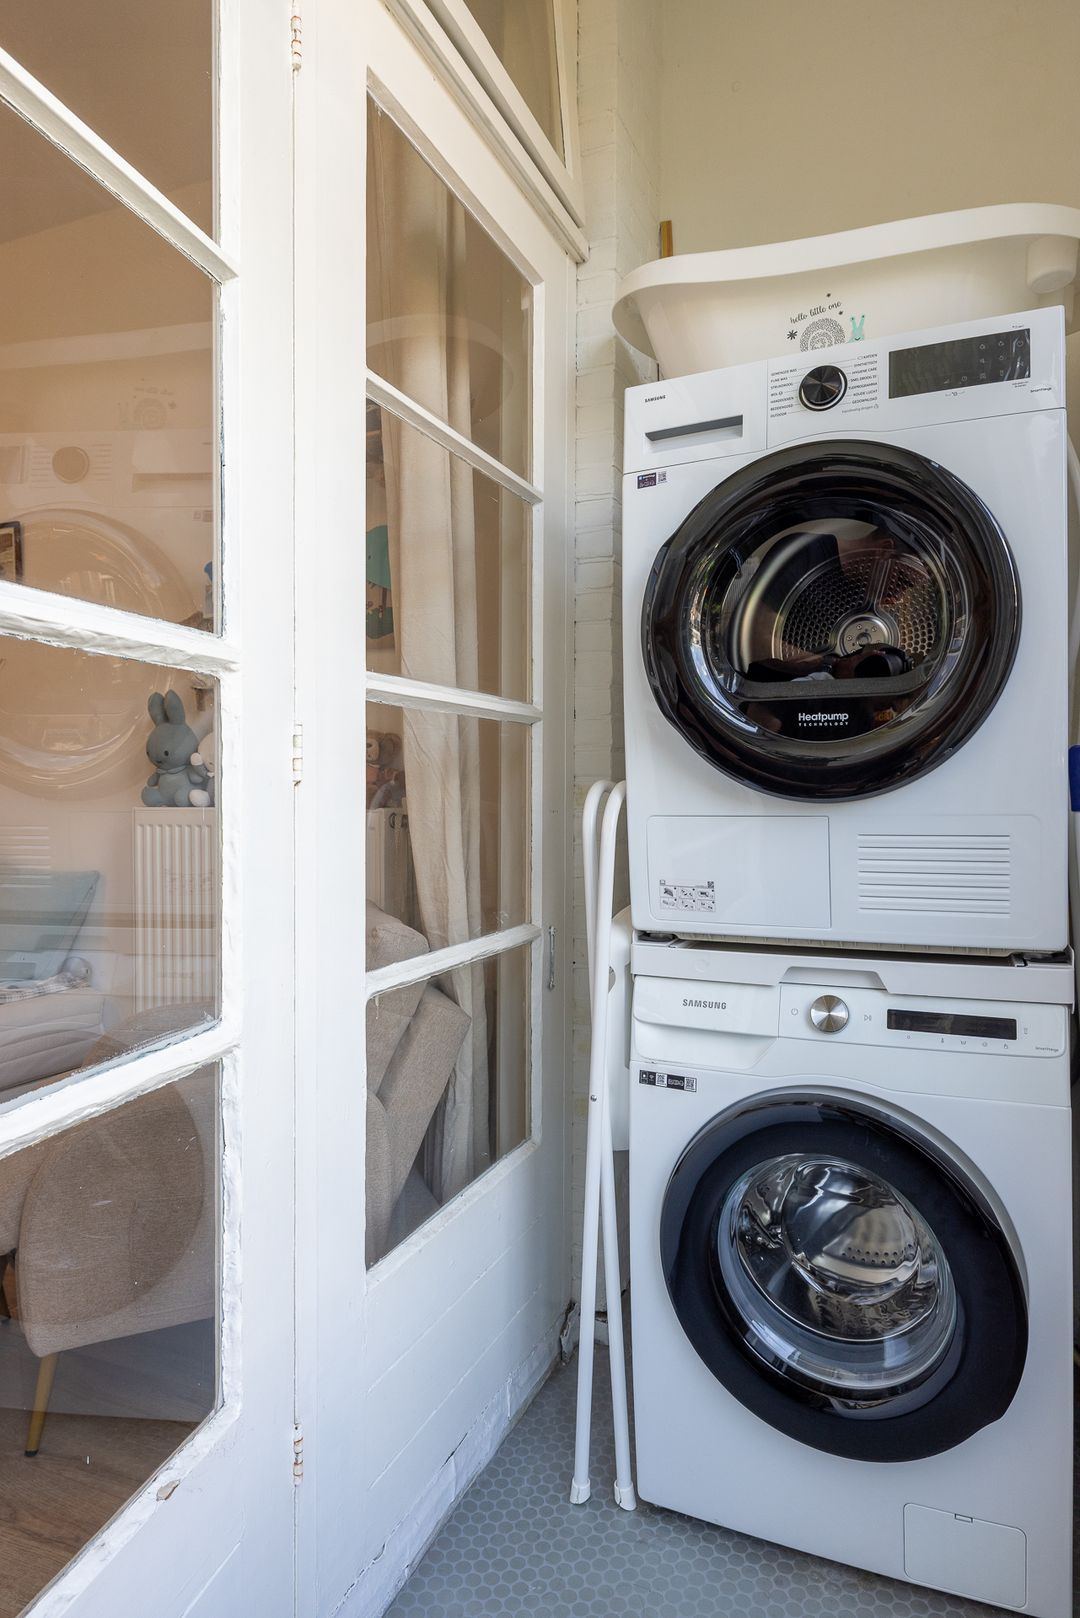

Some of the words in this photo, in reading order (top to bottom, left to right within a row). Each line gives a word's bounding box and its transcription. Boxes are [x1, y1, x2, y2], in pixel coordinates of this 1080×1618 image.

[790, 313, 808, 324] hello
[828, 301, 841, 310] one
[798, 712, 849, 722] Heatpump
[682, 998, 727, 1010] SAMSUNG
